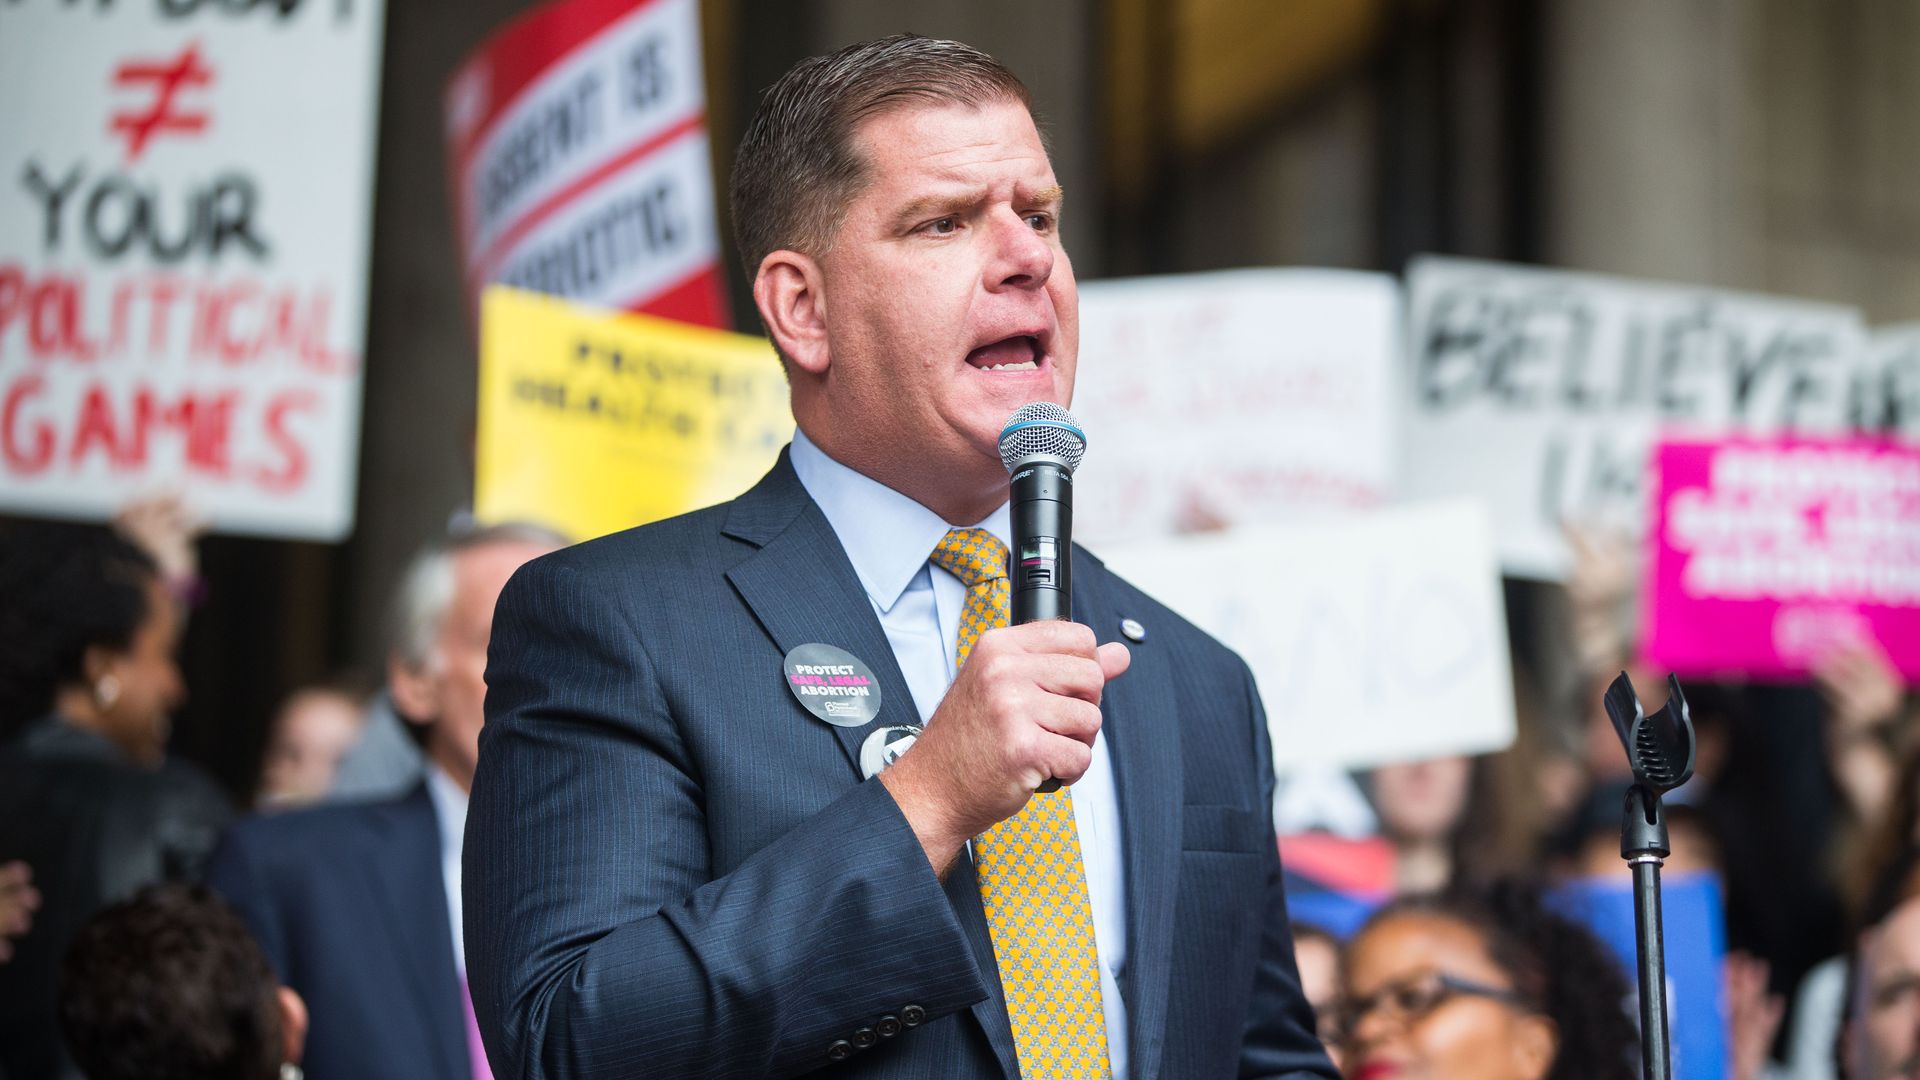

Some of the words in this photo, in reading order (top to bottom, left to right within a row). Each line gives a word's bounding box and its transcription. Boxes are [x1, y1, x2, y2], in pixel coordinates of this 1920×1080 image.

[22, 156, 270, 264] YOUR
[0, 262, 358, 378] POLITICAL
[2, 374, 324, 494] GAMES
[789, 673, 828, 687] SAFE,
[828, 674, 871, 686] LEGAL
[795, 664, 855, 676] PROTECT
[800, 685, 870, 697] ABORTION
